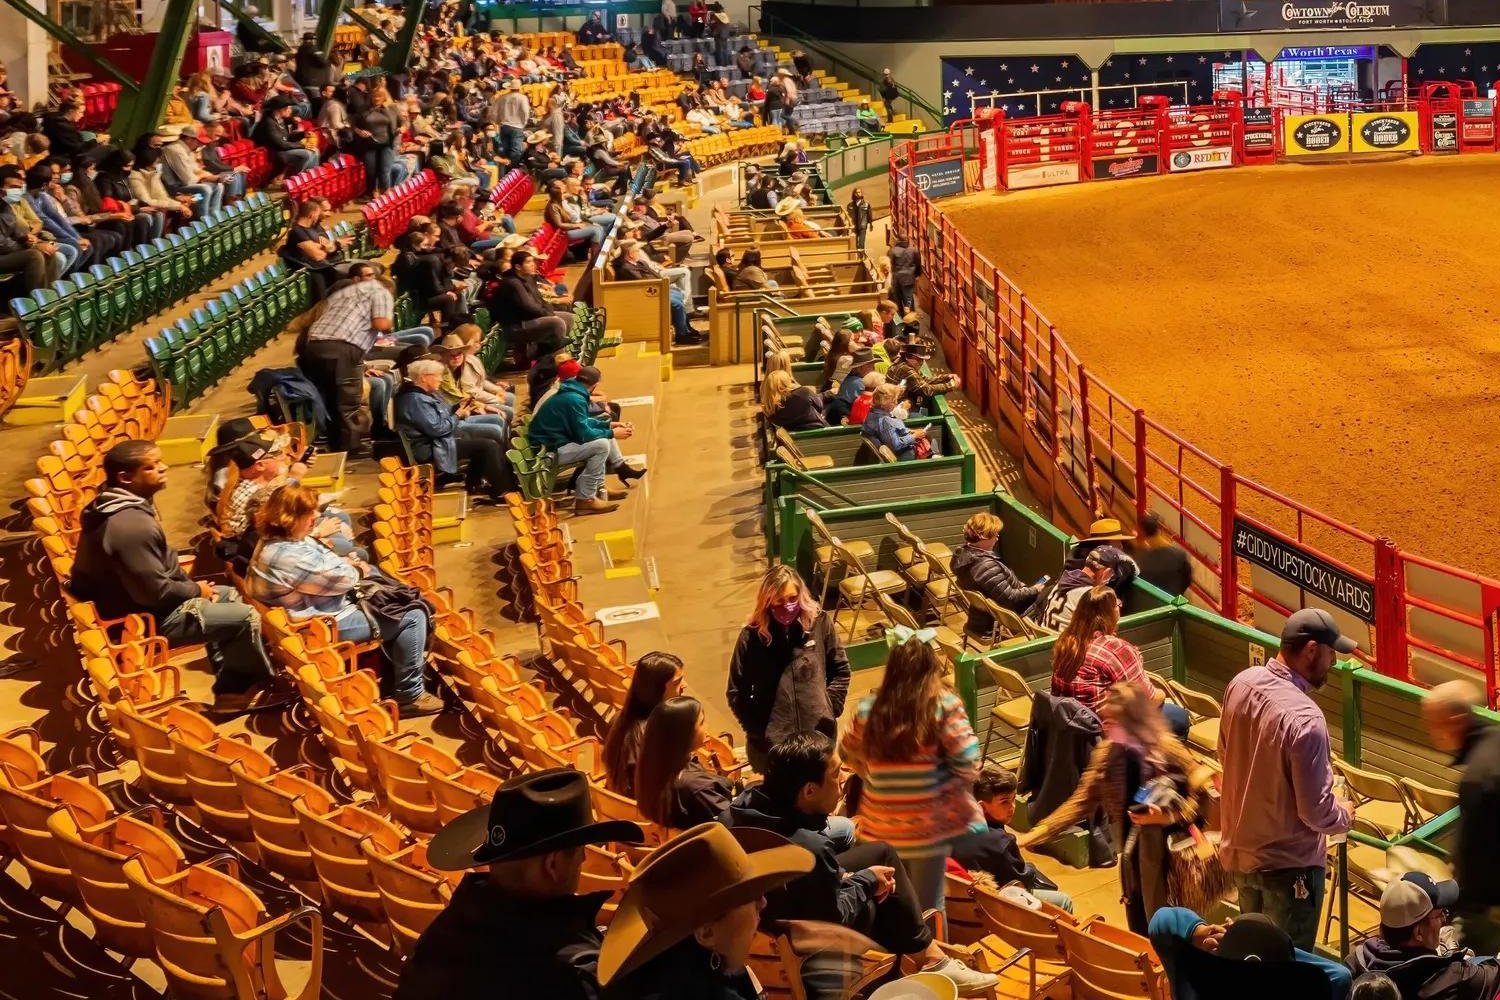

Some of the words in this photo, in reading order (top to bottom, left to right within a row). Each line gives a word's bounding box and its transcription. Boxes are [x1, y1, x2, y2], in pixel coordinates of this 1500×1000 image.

[1281, 3, 1330, 21] COWTOWN
[1345, 1, 1390, 19] COLISEUM
[1287, 47, 1324, 57] Worth
[1326, 46, 1358, 56] Texas
[1306, 136, 1330, 144] RODEO
[1373, 134, 1398, 142] RODEO
[1047, 169, 1070, 177] ULTRA
[1236, 530, 1371, 613] #GIDDYUPSTOCKYARDS
